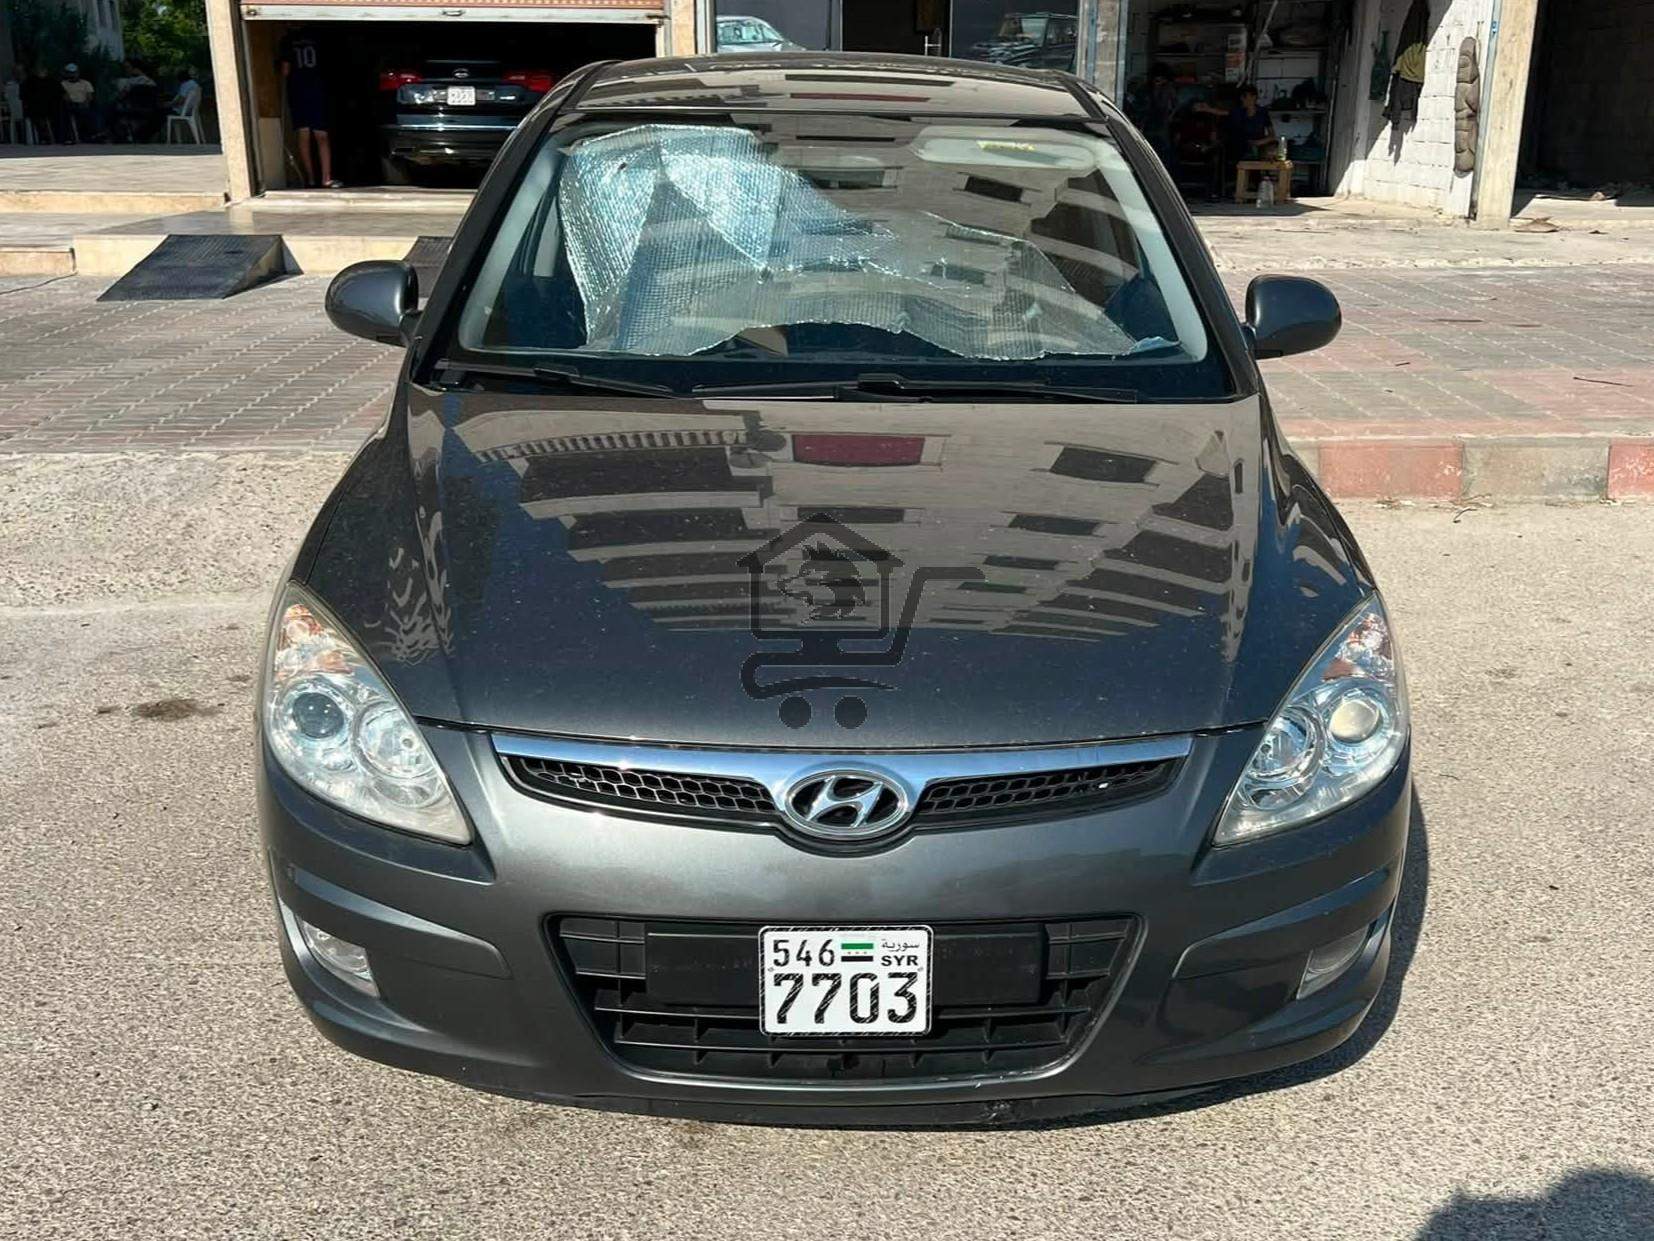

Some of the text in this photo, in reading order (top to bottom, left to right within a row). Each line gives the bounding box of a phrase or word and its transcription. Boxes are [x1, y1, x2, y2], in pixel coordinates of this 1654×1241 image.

[293, 46, 317, 68] 10
[773, 938, 835, 967] 546
[881, 938, 920, 953] سورية
[881, 955, 918, 967] SYR
[773, 972, 918, 1024] 7703
